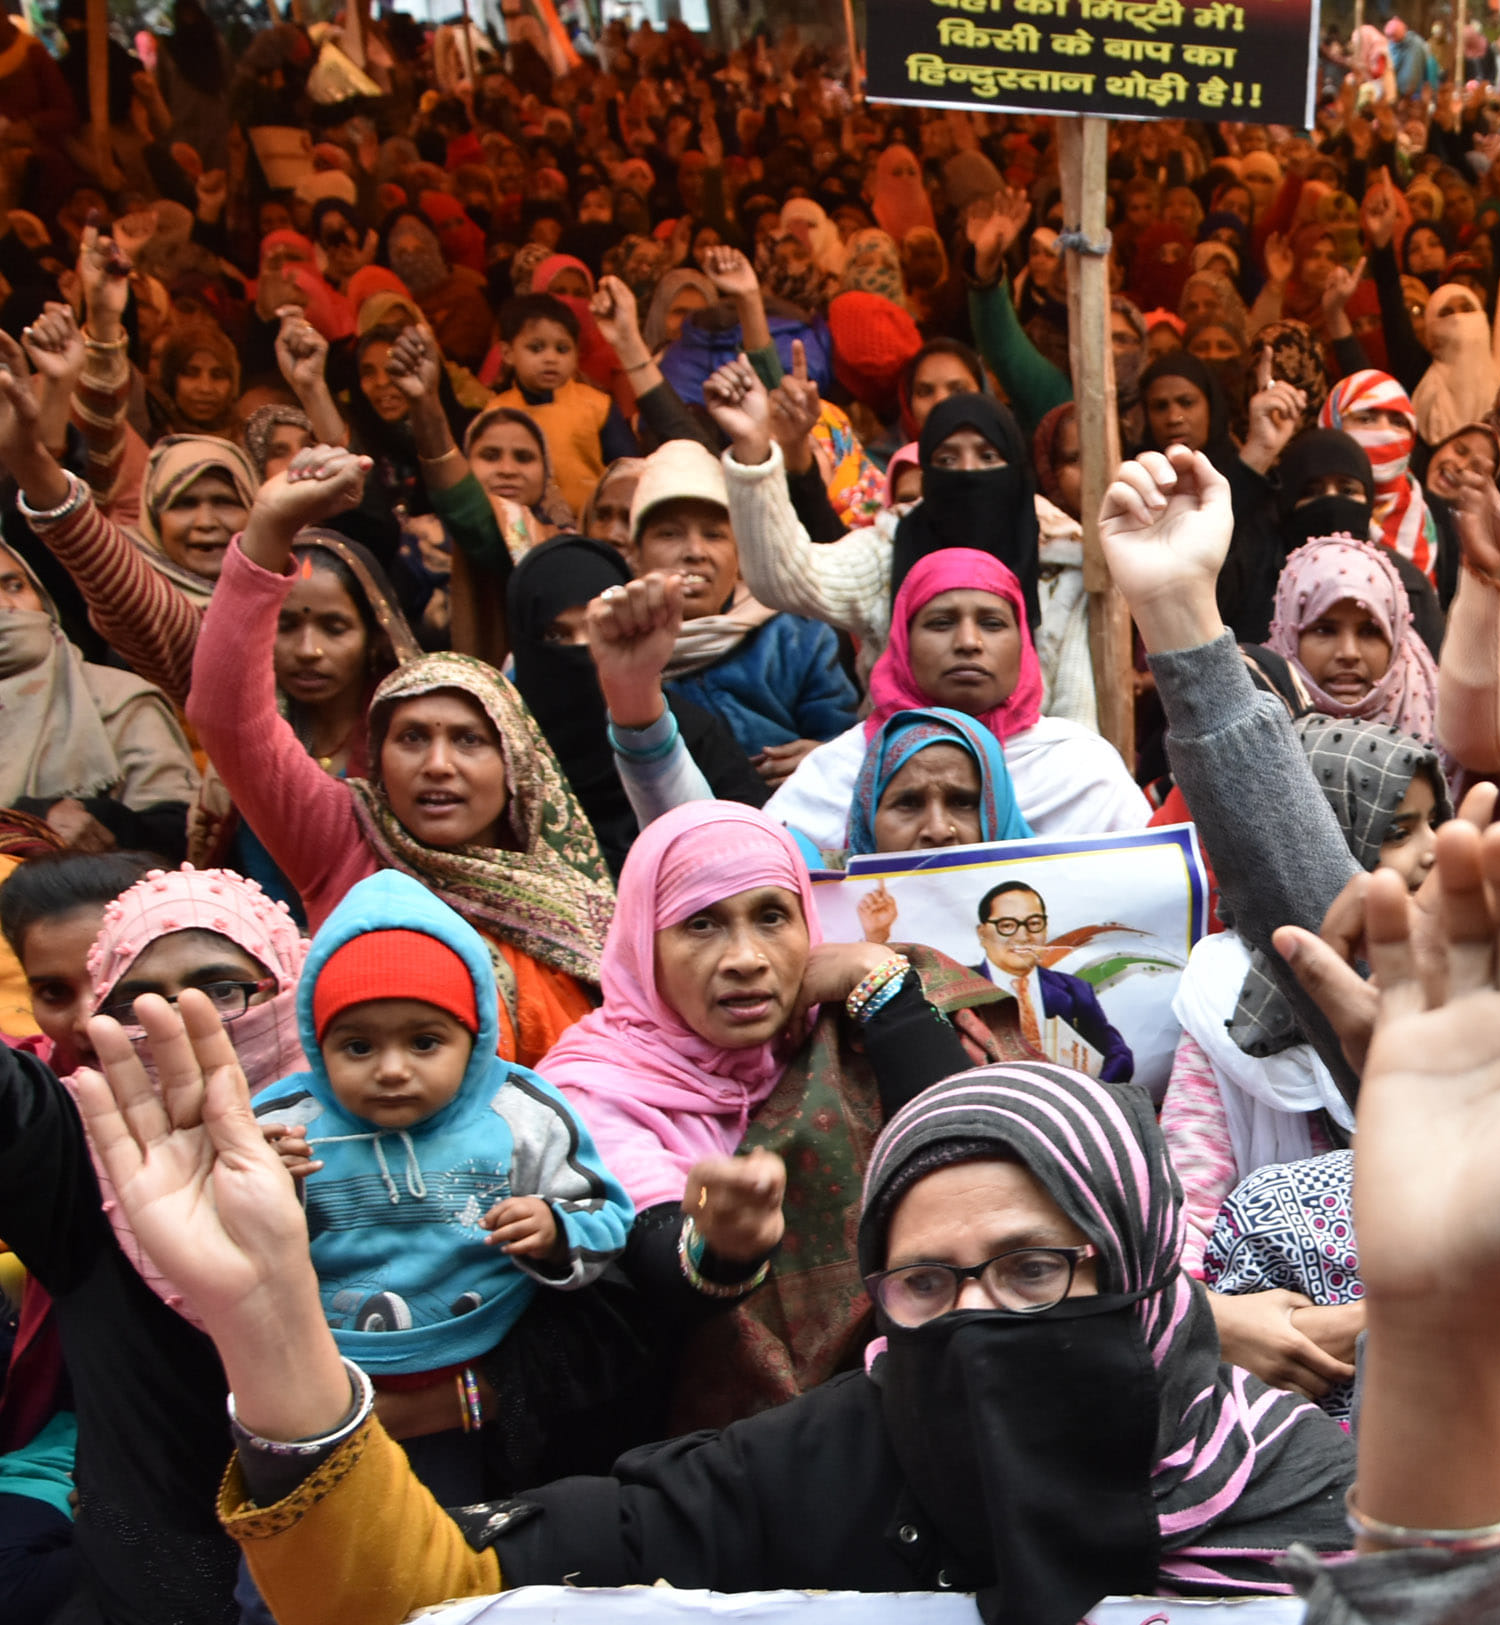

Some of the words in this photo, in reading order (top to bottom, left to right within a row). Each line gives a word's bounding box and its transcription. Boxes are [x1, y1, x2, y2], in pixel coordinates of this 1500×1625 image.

[1193, 1, 1245, 32] में!
[936, 17, 1042, 53] किसी
[1050, 27, 1095, 56] के
[1103, 37, 1174, 64] बाप
[1181, 44, 1238, 69] का
[905, 52, 1097, 99] हिन्दुस्तान
[1105, 70, 1190, 107] थोड़ी
